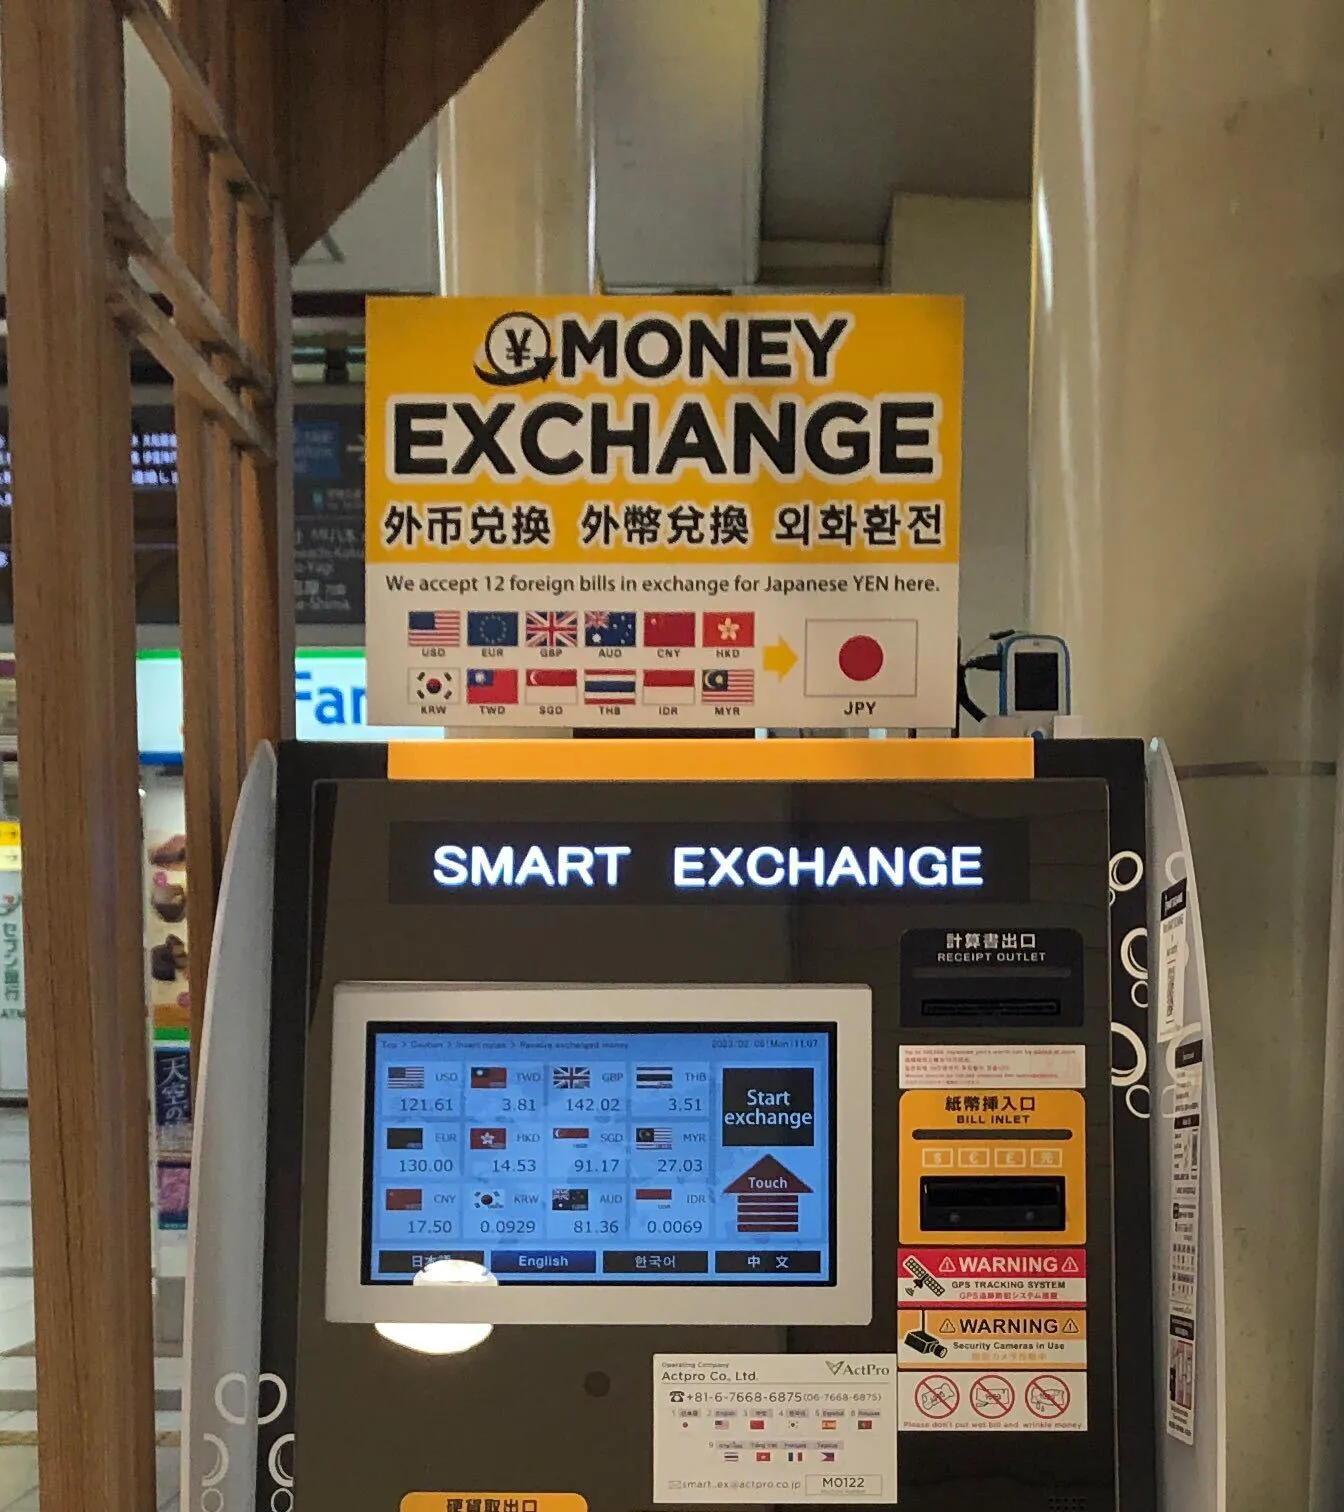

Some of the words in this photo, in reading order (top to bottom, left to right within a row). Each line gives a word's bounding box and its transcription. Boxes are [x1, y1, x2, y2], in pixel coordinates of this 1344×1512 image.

[561, 318, 848, 379] MONEY
[394, 402, 934, 476] EXCHANGE
[384, 504, 551, 548] 外币兑换
[582, 504, 748, 548] 外幣兌換
[774, 504, 944, 548] 외화환전
[385, 575, 413, 592] We
[418, 577, 478, 594] accept
[485, 575, 505, 592] 12
[510, 575, 574, 594] foreign
[580, 575, 615, 592] bills
[621, 575, 637, 592] in
[642, 575, 729, 595] exchange
[735, 575, 759, 592] for
[765, 576, 848, 595] Japanese
[854, 575, 888, 592] YEN
[894, 575, 940, 592] here.
[422, 648, 445, 658] USD
[482, 648, 503, 658] EUR
[540, 648, 562, 658] GBP
[657, 648, 680, 658] CNY
[716, 648, 740, 658] HKD
[420, 705, 447, 715] KRW
[479, 705, 505, 715] TWD
[539, 705, 562, 715] SGD
[598, 705, 621, 715] THB
[658, 705, 677, 715] IDR
[714, 705, 740, 715] MYR
[844, 701, 876, 716] JPY
[433, 844, 632, 887] SMART
[673, 844, 983, 887] EXCHANGE
[947, 933, 1036, 949] 計算書出口
[937, 952, 992, 962] RECEIPT
[996, 952, 1046, 962] OUTLET
[435, 1072, 458, 1082] USD
[516, 1072, 541, 1082] TWD
[601, 1072, 624, 1082] GBP
[684, 1072, 707, 1082] THB
[400, 1097, 453, 1112] 121.61
[502, 1097, 536, 1112] 3.81
[566, 1097, 620, 1112] 142.02
[668, 1097, 702, 1112] 3.51
[747, 1089, 790, 1106] Start
[945, 1095, 1036, 1113] 紙幣挿入口
[724, 1109, 813, 1128] exchange
[956, 1115, 987, 1125] BILL
[991, 1114, 1030, 1124] INLET
[435, 1133, 456, 1142] EUR
[517, 1133, 540, 1142] HKD
[600, 1133, 623, 1142] SGD
[683, 1133, 706, 1142] MYR
[399, 1159, 453, 1173] 130.00
[492, 1159, 536, 1173] 14.53
[574, 1159, 619, 1173] 91.17
[657, 1159, 703, 1173] 27.03
[748, 1176, 788, 1189] Touch
[434, 1194, 456, 1204] CNY
[514, 1194, 539, 1204] KRW
[599, 1194, 622, 1204] AUD
[687, 1194, 705, 1204] IDR
[408, 1220, 452, 1234] 17.50
[480, 1220, 536, 1234] 0.0929
[573, 1220, 619, 1234] 81.36
[647, 1220, 702, 1234] 0.0069
[411, 1255, 451, 1268] 日本
[519, 1255, 569, 1269] English
[634, 1255, 676, 1269] 한국어
[959, 1256, 1058, 1273] WARNING
[952, 1281, 973, 1289] GPS
[976, 1281, 1023, 1289] TRACKING
[960, 1318, 1058, 1334] WARNING
[953, 1341, 990, 1351] Security
[993, 1341, 1032, 1350] Cameras
[1036, 1342, 1044, 1350] in
[1047, 1341, 1065, 1350] Use
[662, 1372, 705, 1381] Actpro
[736, 1372, 758, 1381] Ltd.
[844, 1366, 889, 1376] ActPro
[956, 1422, 970, 1430] put
